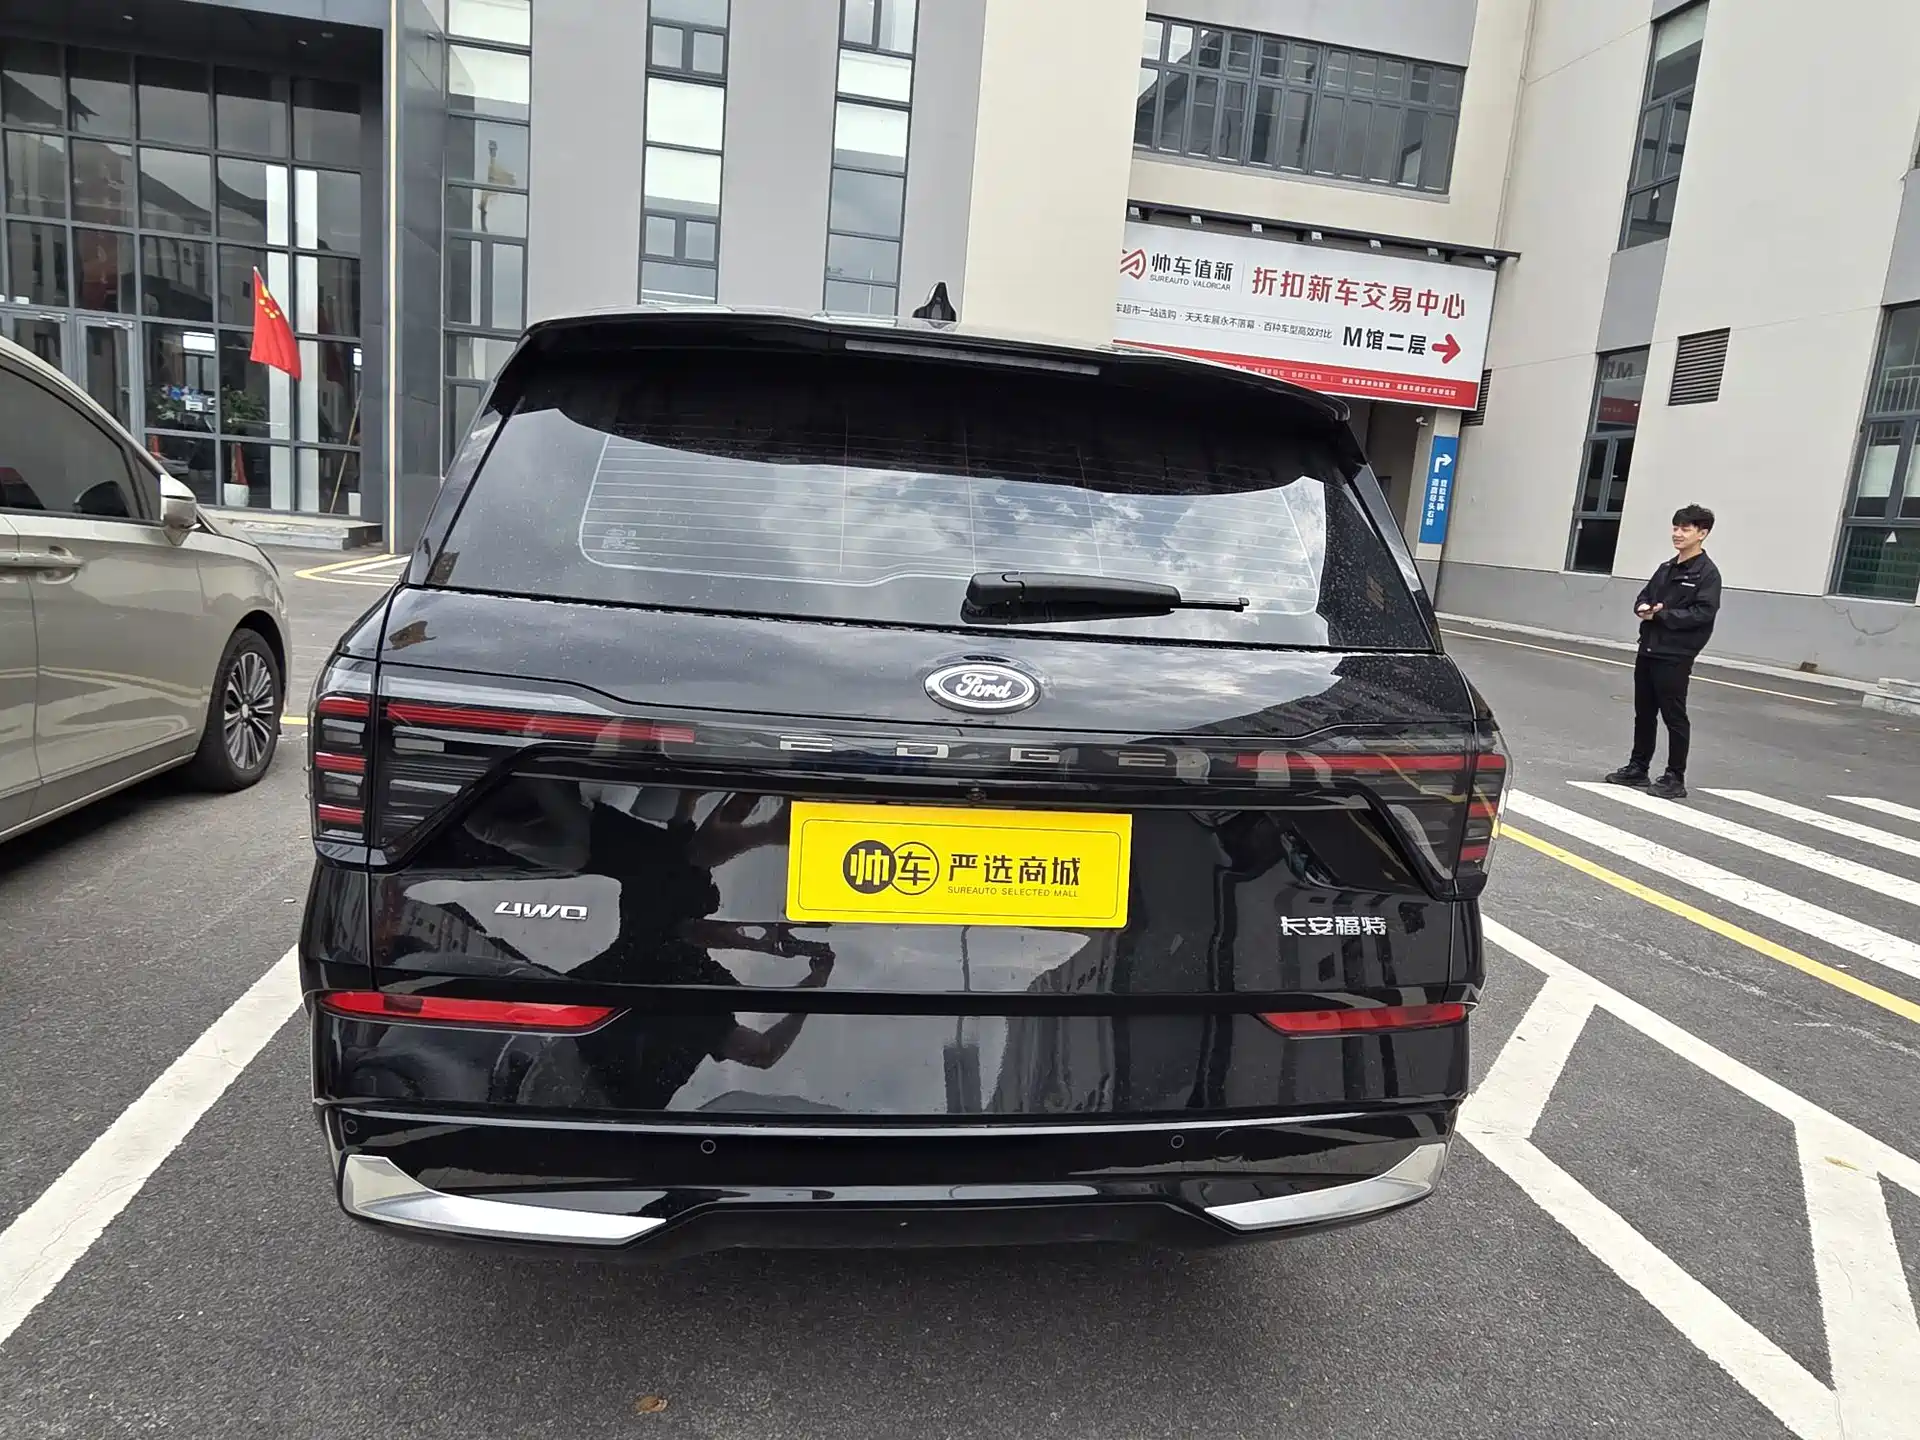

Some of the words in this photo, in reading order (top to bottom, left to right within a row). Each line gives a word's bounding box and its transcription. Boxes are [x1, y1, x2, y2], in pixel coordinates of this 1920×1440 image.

[1151, 253, 1234, 282] 帅车值新
[1150, 274, 1190, 286] SUREAUTO
[1193, 280, 1231, 292] VALORCAR
[1252, 266, 1466, 320] 折扣新车交易中心
[1343, 325, 1427, 356] M馆二层
[955, 671, 1012, 701] Ford
[779, 734, 1168, 768] EDGE
[847, 845, 935, 890] 帅车
[947, 853, 1081, 887] 严选商城
[948, 885, 997, 896] SUREAUTO
[1001, 886, 1050, 898] SELECTED
[1053, 889, 1079, 899] MALL
[494, 901, 589, 920] 4WD
[1280, 915, 1387, 936] 长安福特
